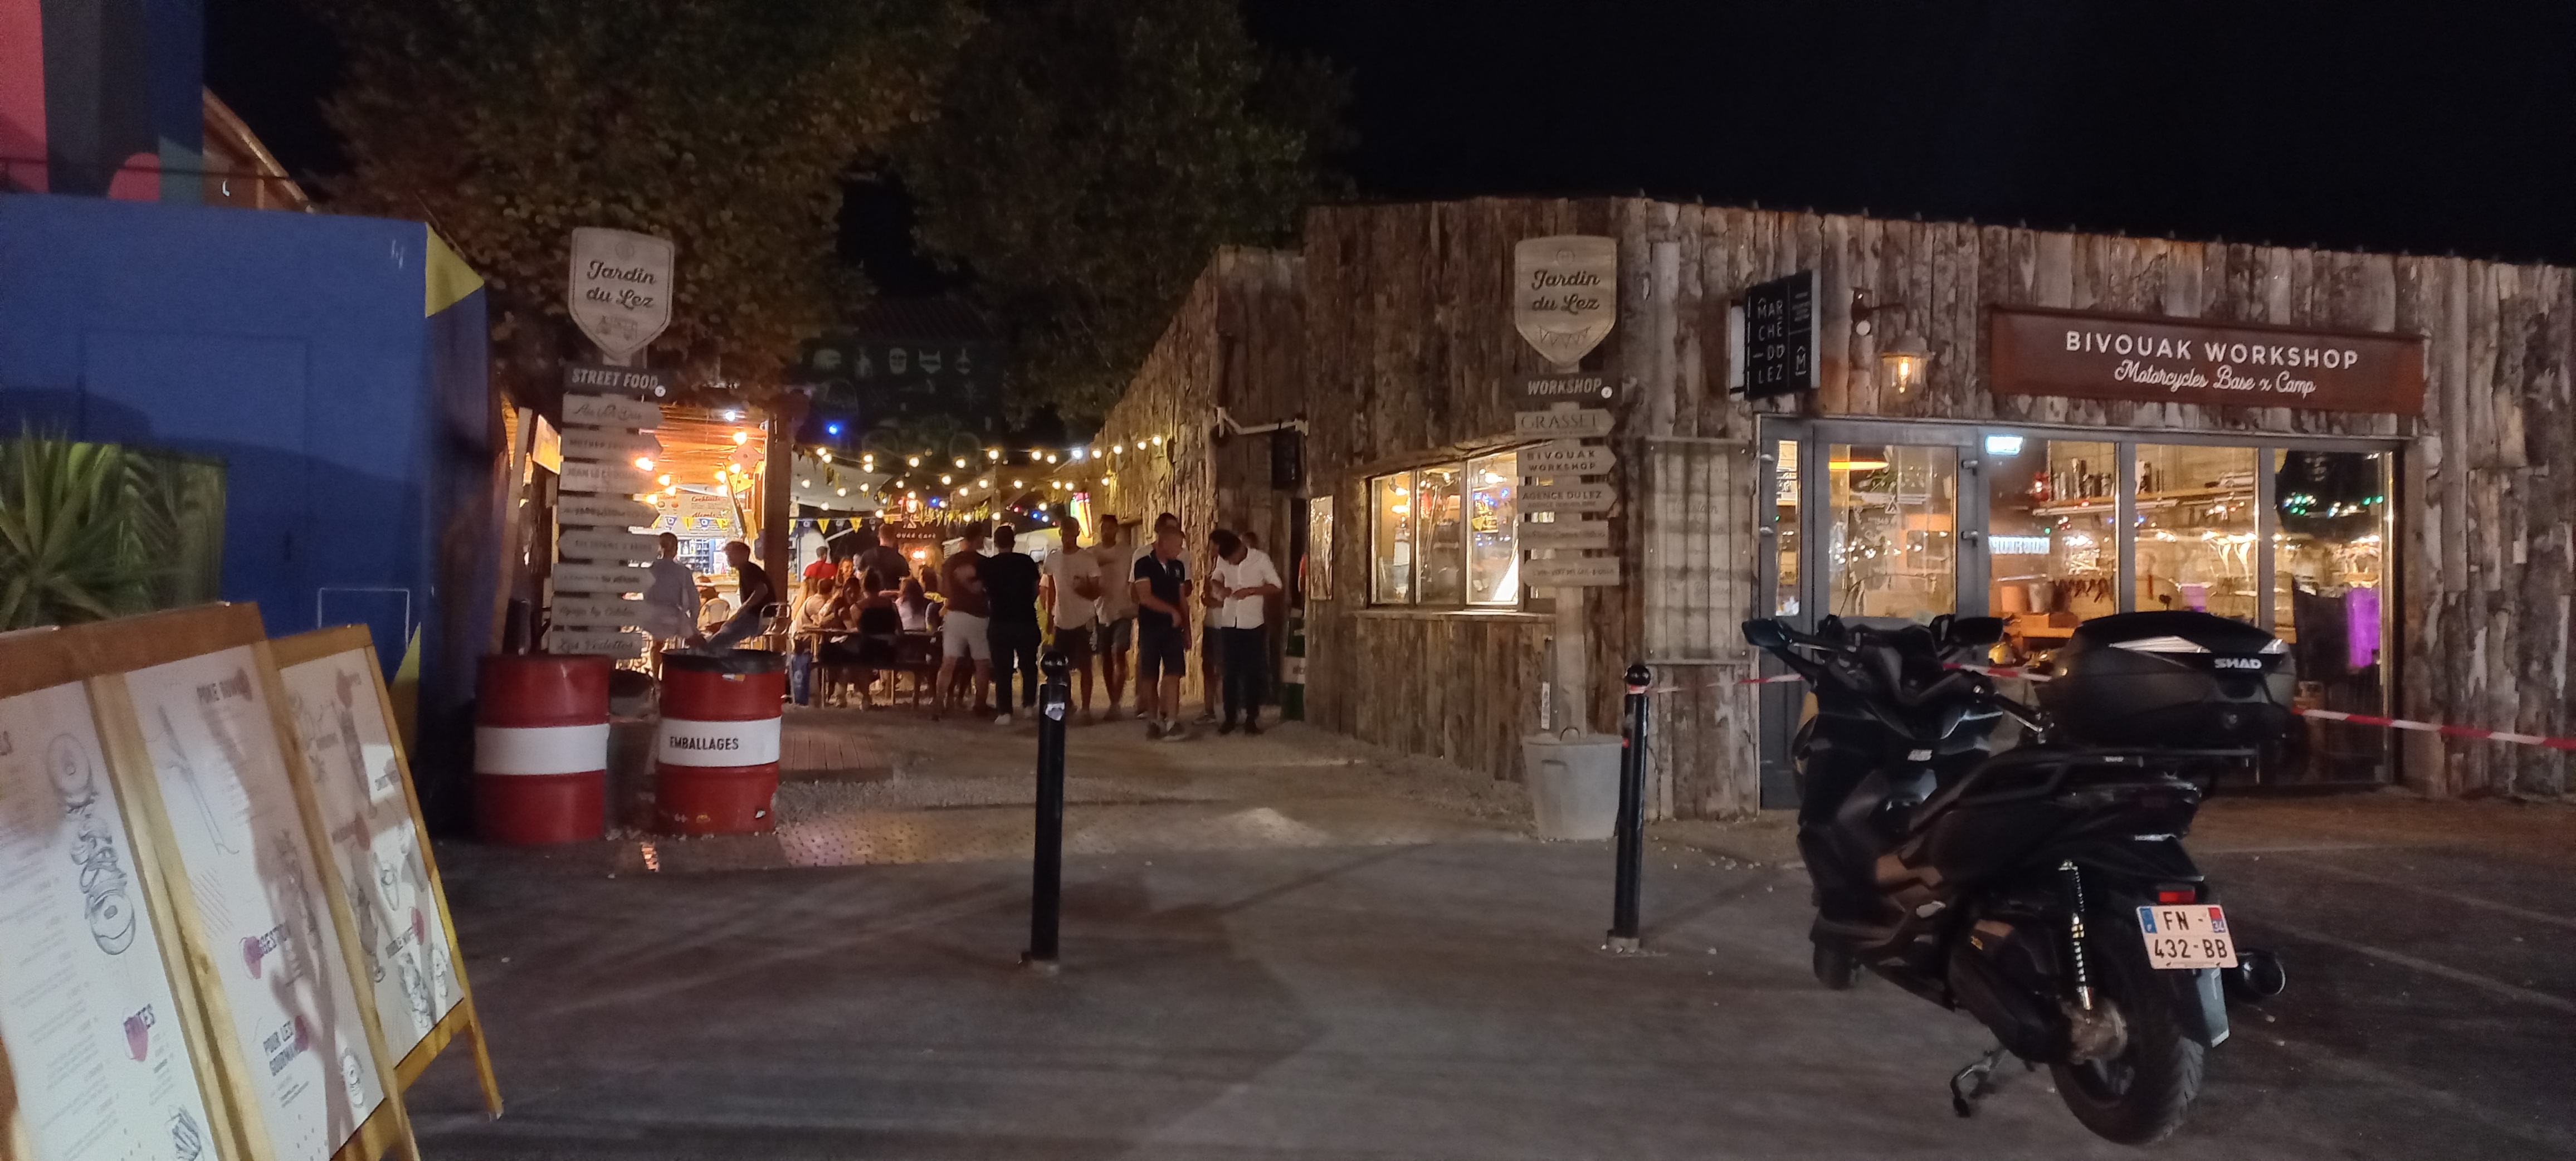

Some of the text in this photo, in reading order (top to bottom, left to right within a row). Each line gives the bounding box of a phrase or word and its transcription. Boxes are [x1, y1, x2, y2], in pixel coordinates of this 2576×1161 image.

[587, 259, 655, 284] Jardin
[1531, 269, 1600, 290] Jardin
[586, 287, 653, 310] du Lez
[1533, 294, 1599, 315] du Lez
[2066, 330, 2358, 369] BIVOUAK WORKSHOP
[572, 368, 658, 389] STREET FOOD
[1759, 364, 1783, 384] LEZ
[2114, 359, 2209, 392] Motorcycles
[2212, 364, 2256, 390] Base
[2275, 370, 2318, 399] Camp
[1528, 378, 1602, 396] WORKSHOP
[1527, 450, 1595, 461] BIVOUAK
[1529, 462, 1596, 472] WORKSHOP
[670, 736, 739, 750] EMBALLAGES
[2154, 939, 2228, 958] 432-BB
